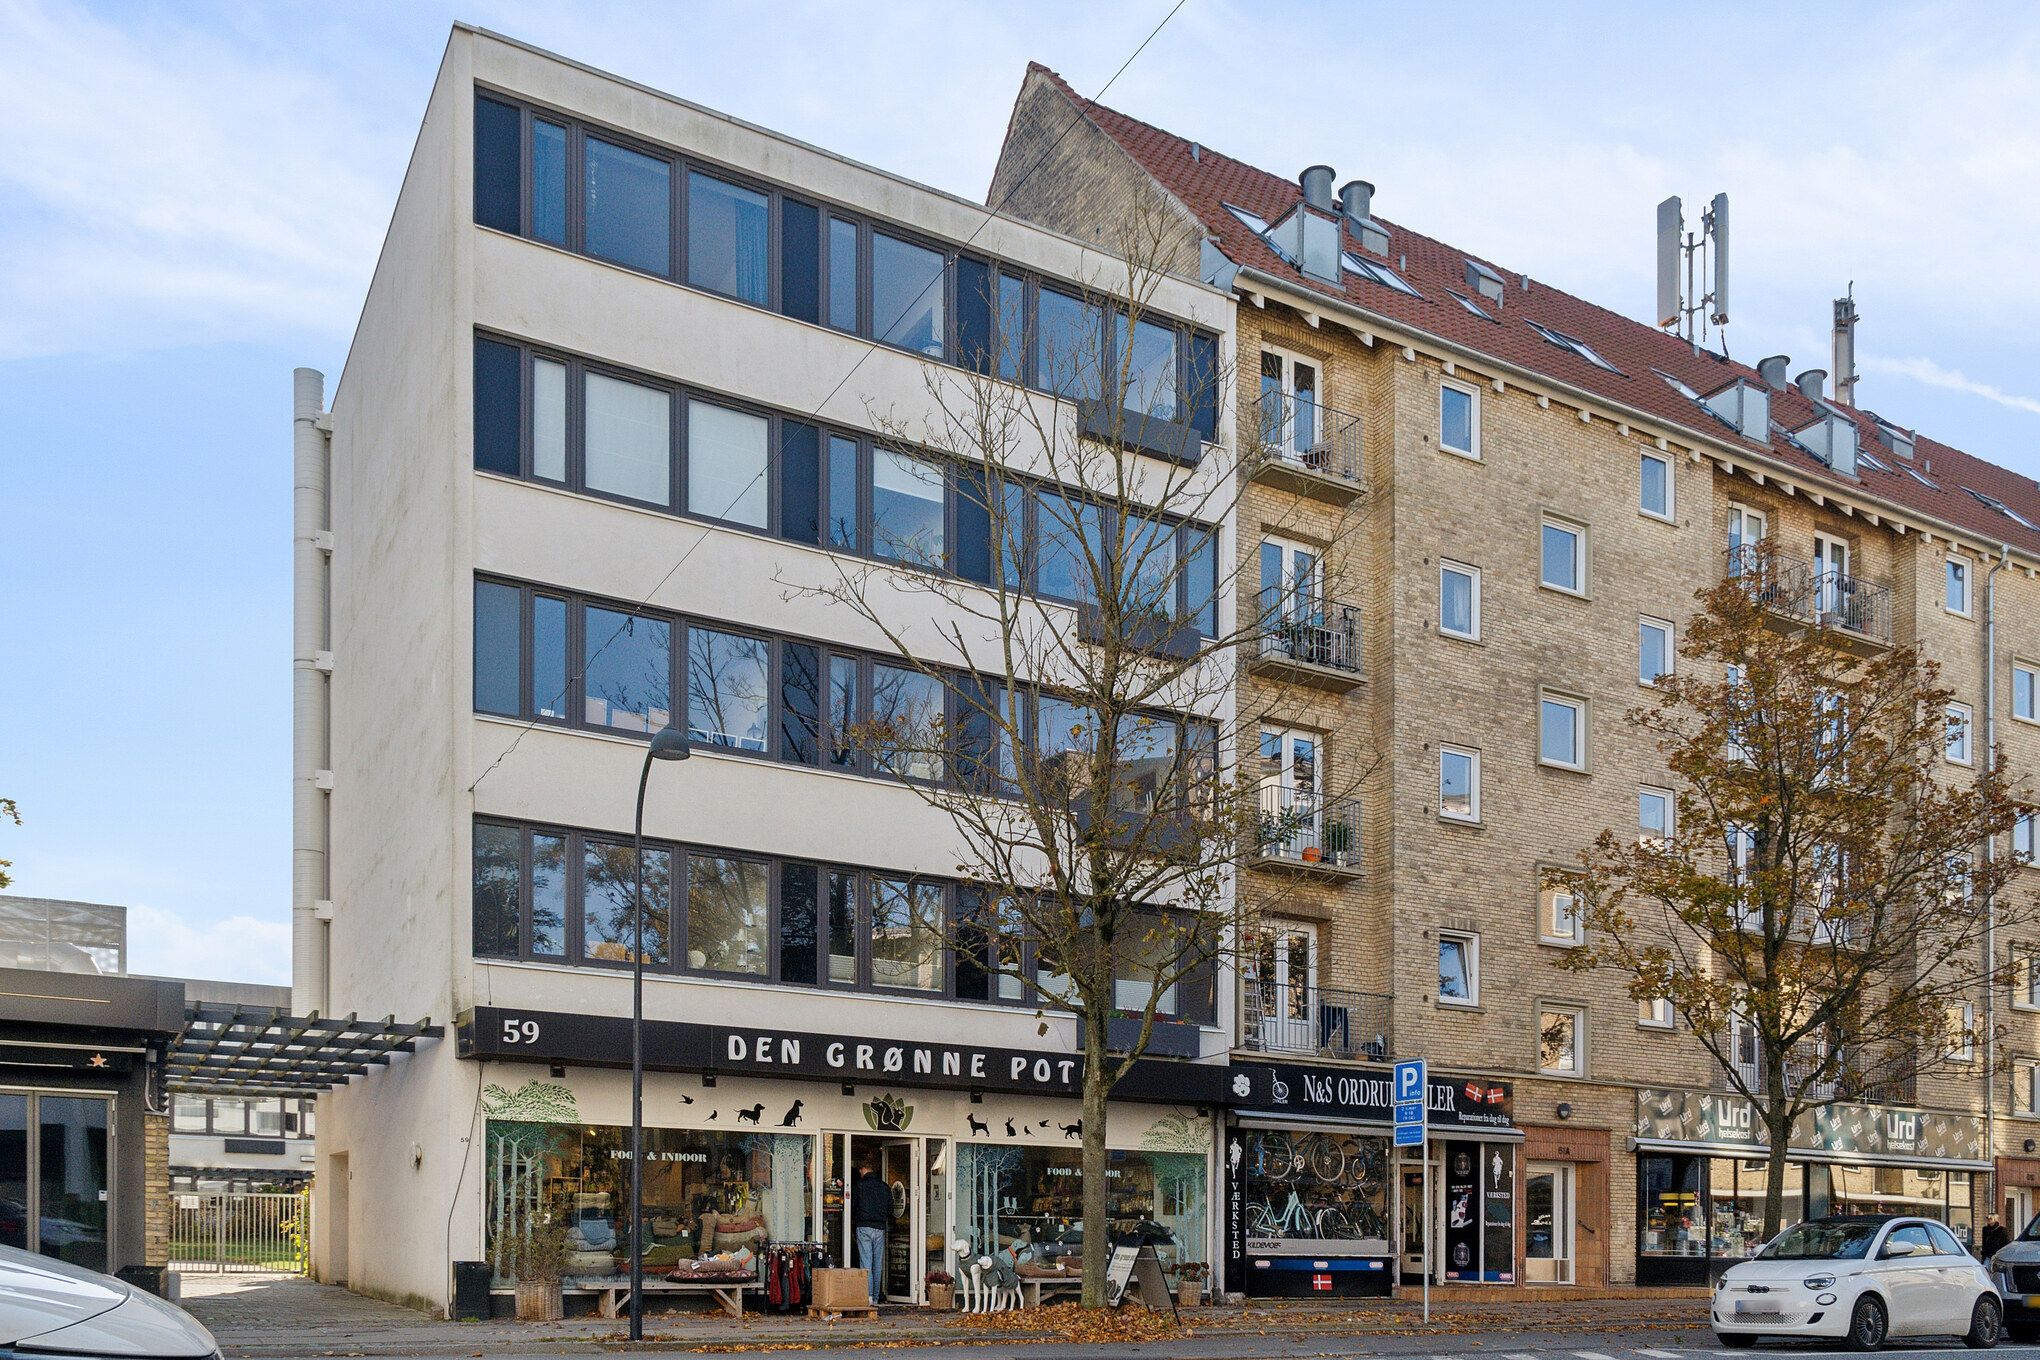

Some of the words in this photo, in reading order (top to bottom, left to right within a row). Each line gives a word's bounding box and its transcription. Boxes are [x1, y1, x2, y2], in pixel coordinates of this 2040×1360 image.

[502, 1019, 540, 1044] 59
[728, 1035, 800, 1065] DEN
[826, 1042, 986, 1078] GRØNNE
[1011, 1057, 1085, 1084] POT
[1303, 1074, 1333, 1103] N&S
[1402, 1067, 1418, 1097] P
[1717, 1099, 1751, 1128] Urd
[1718, 1127, 1750, 1139] helsekost
[1887, 1114, 1916, 1140] Urd
[610, 1150, 633, 1160] FOO
[647, 1151, 657, 1160] &
[661, 1152, 707, 1162] INDOOR
[1887, 1140, 1915, 1151] helsekost
[1047, 1167, 1072, 1176] FOOD
[1074, 1168, 1083, 1176] &
[1231, 1181, 1241, 1259] VÆRKSTED
[1954, 1226, 1968, 1237] Urd
